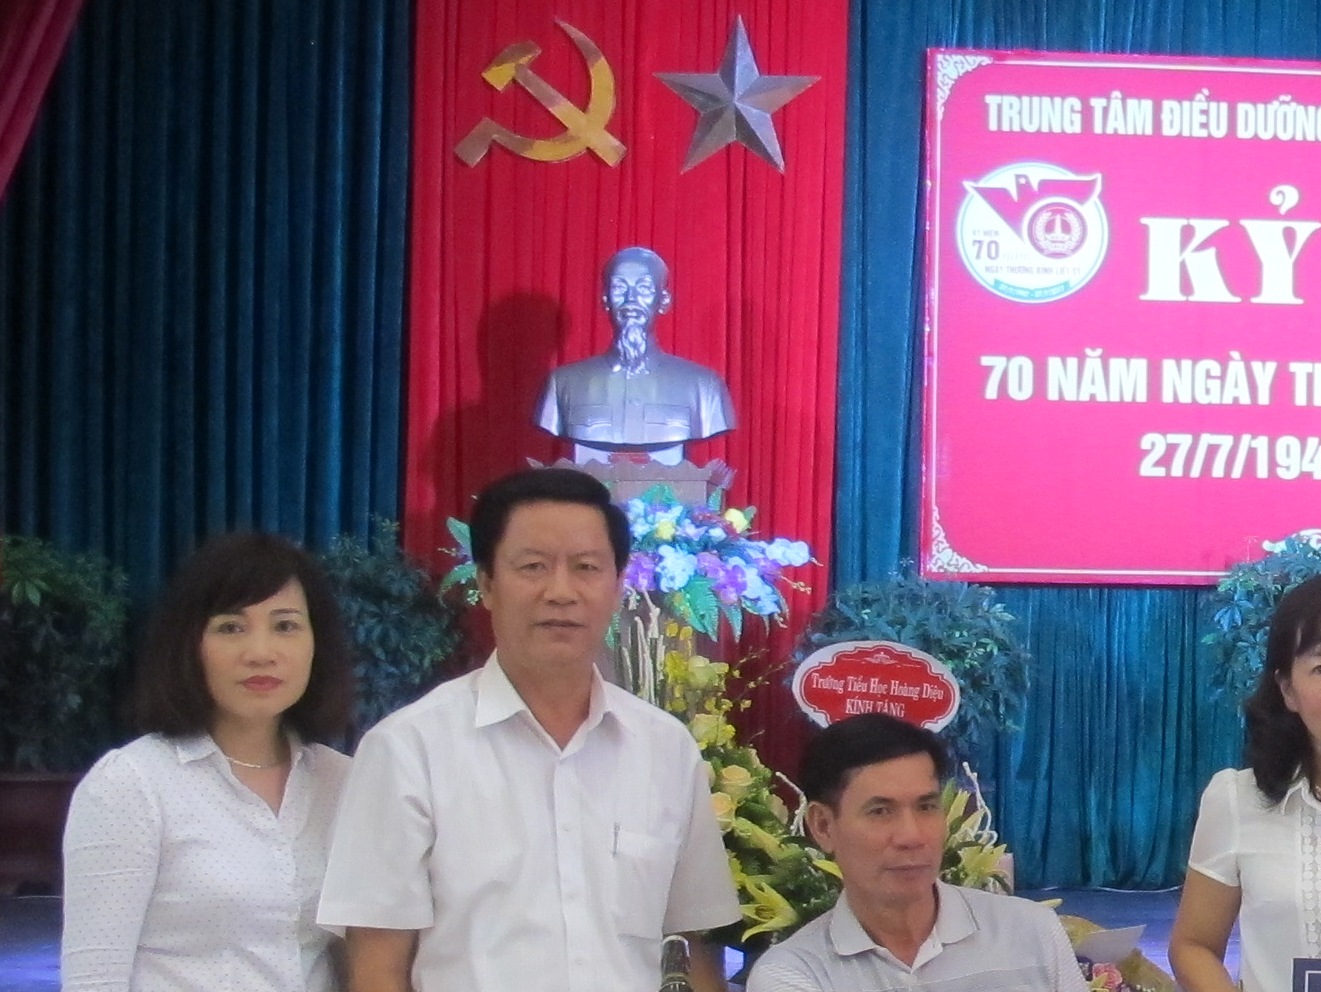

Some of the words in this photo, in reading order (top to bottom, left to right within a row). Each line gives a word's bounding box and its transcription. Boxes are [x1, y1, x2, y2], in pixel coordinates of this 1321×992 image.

[984, 94, 1082, 134] TRUNG
[1090, 90, 1153, 136] TÂM
[1161, 88, 1228, 138] ĐIỀU
[972, 239, 1000, 260] 70
[1139, 184, 1321, 305] KỶ
[980, 355, 1034, 401] 70
[1047, 347, 1148, 403] NĂM
[1162, 350, 1277, 406] NGÀY
